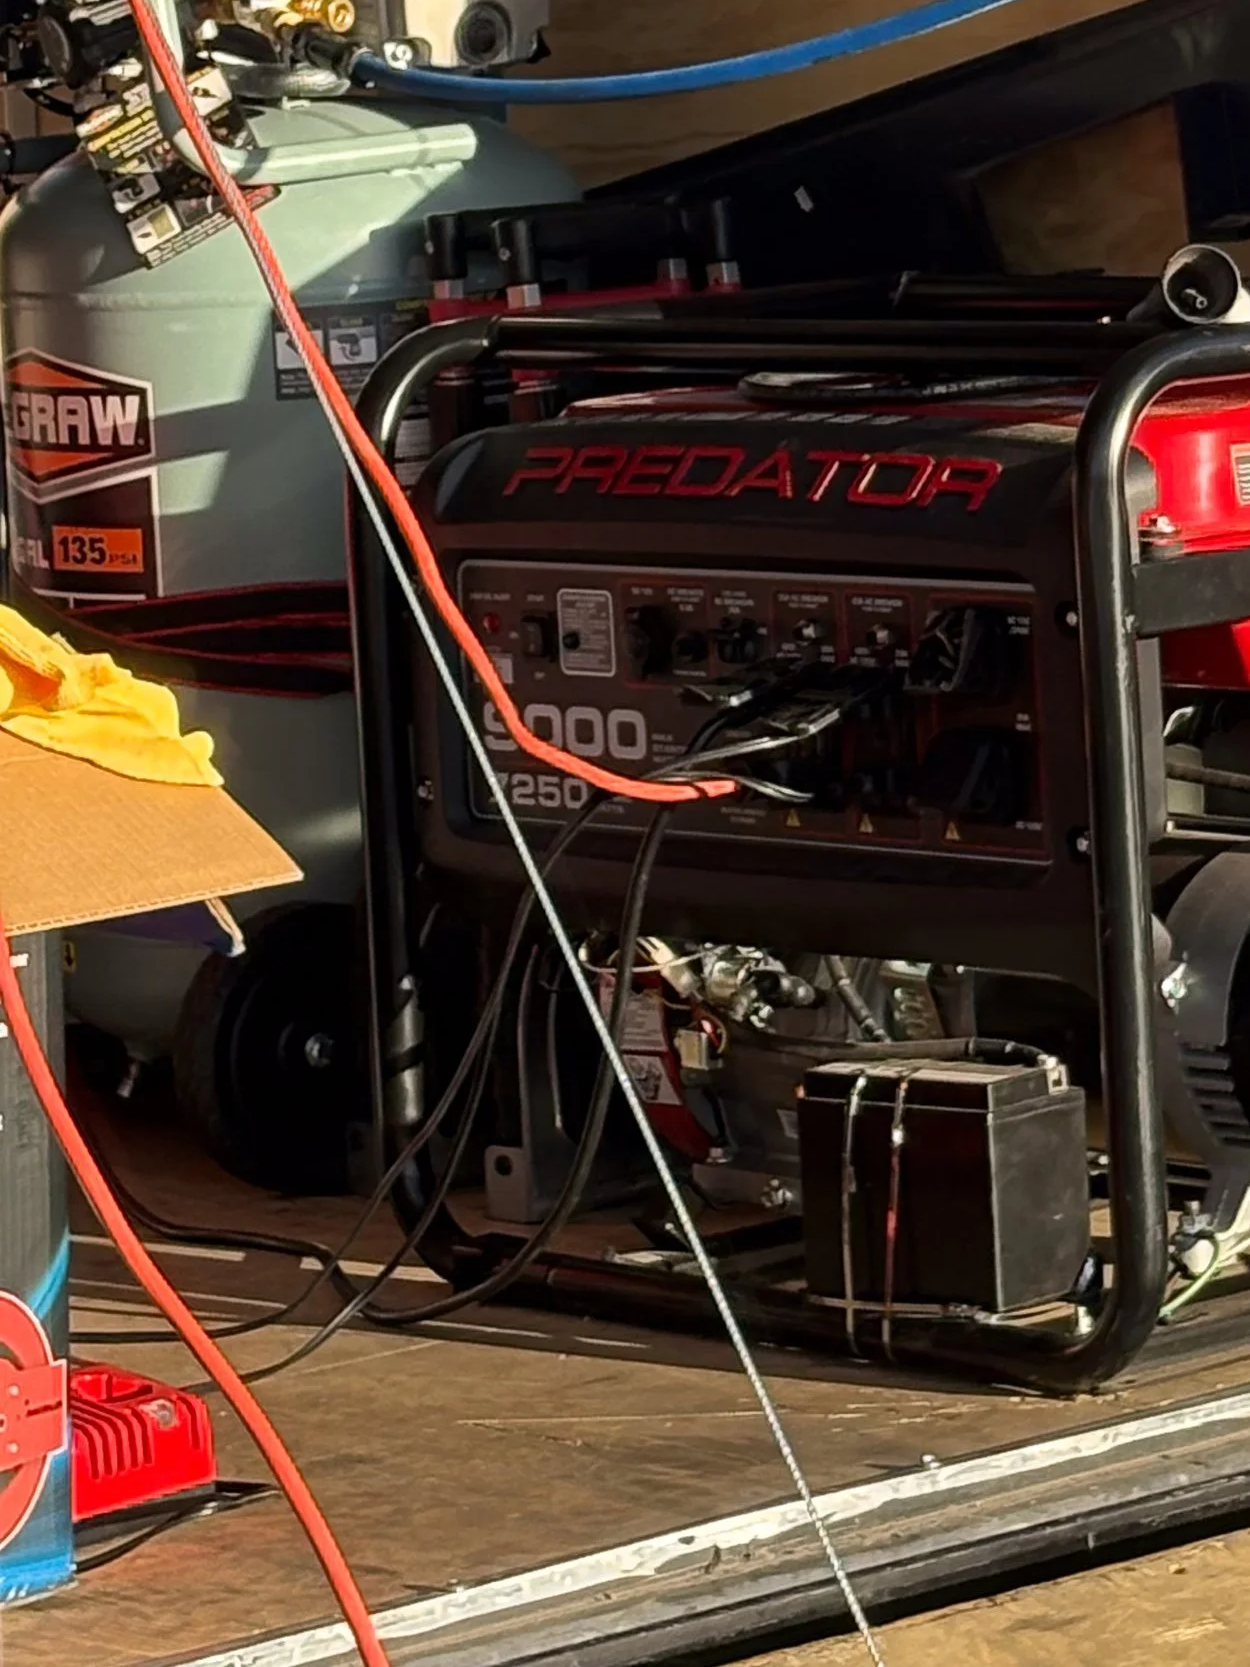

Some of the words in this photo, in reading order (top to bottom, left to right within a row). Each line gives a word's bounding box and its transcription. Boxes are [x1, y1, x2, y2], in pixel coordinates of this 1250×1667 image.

[503, 444, 1003, 512] PREDATOR
[57, 534, 108, 566] 135
[483, 701, 647, 761] 9000
